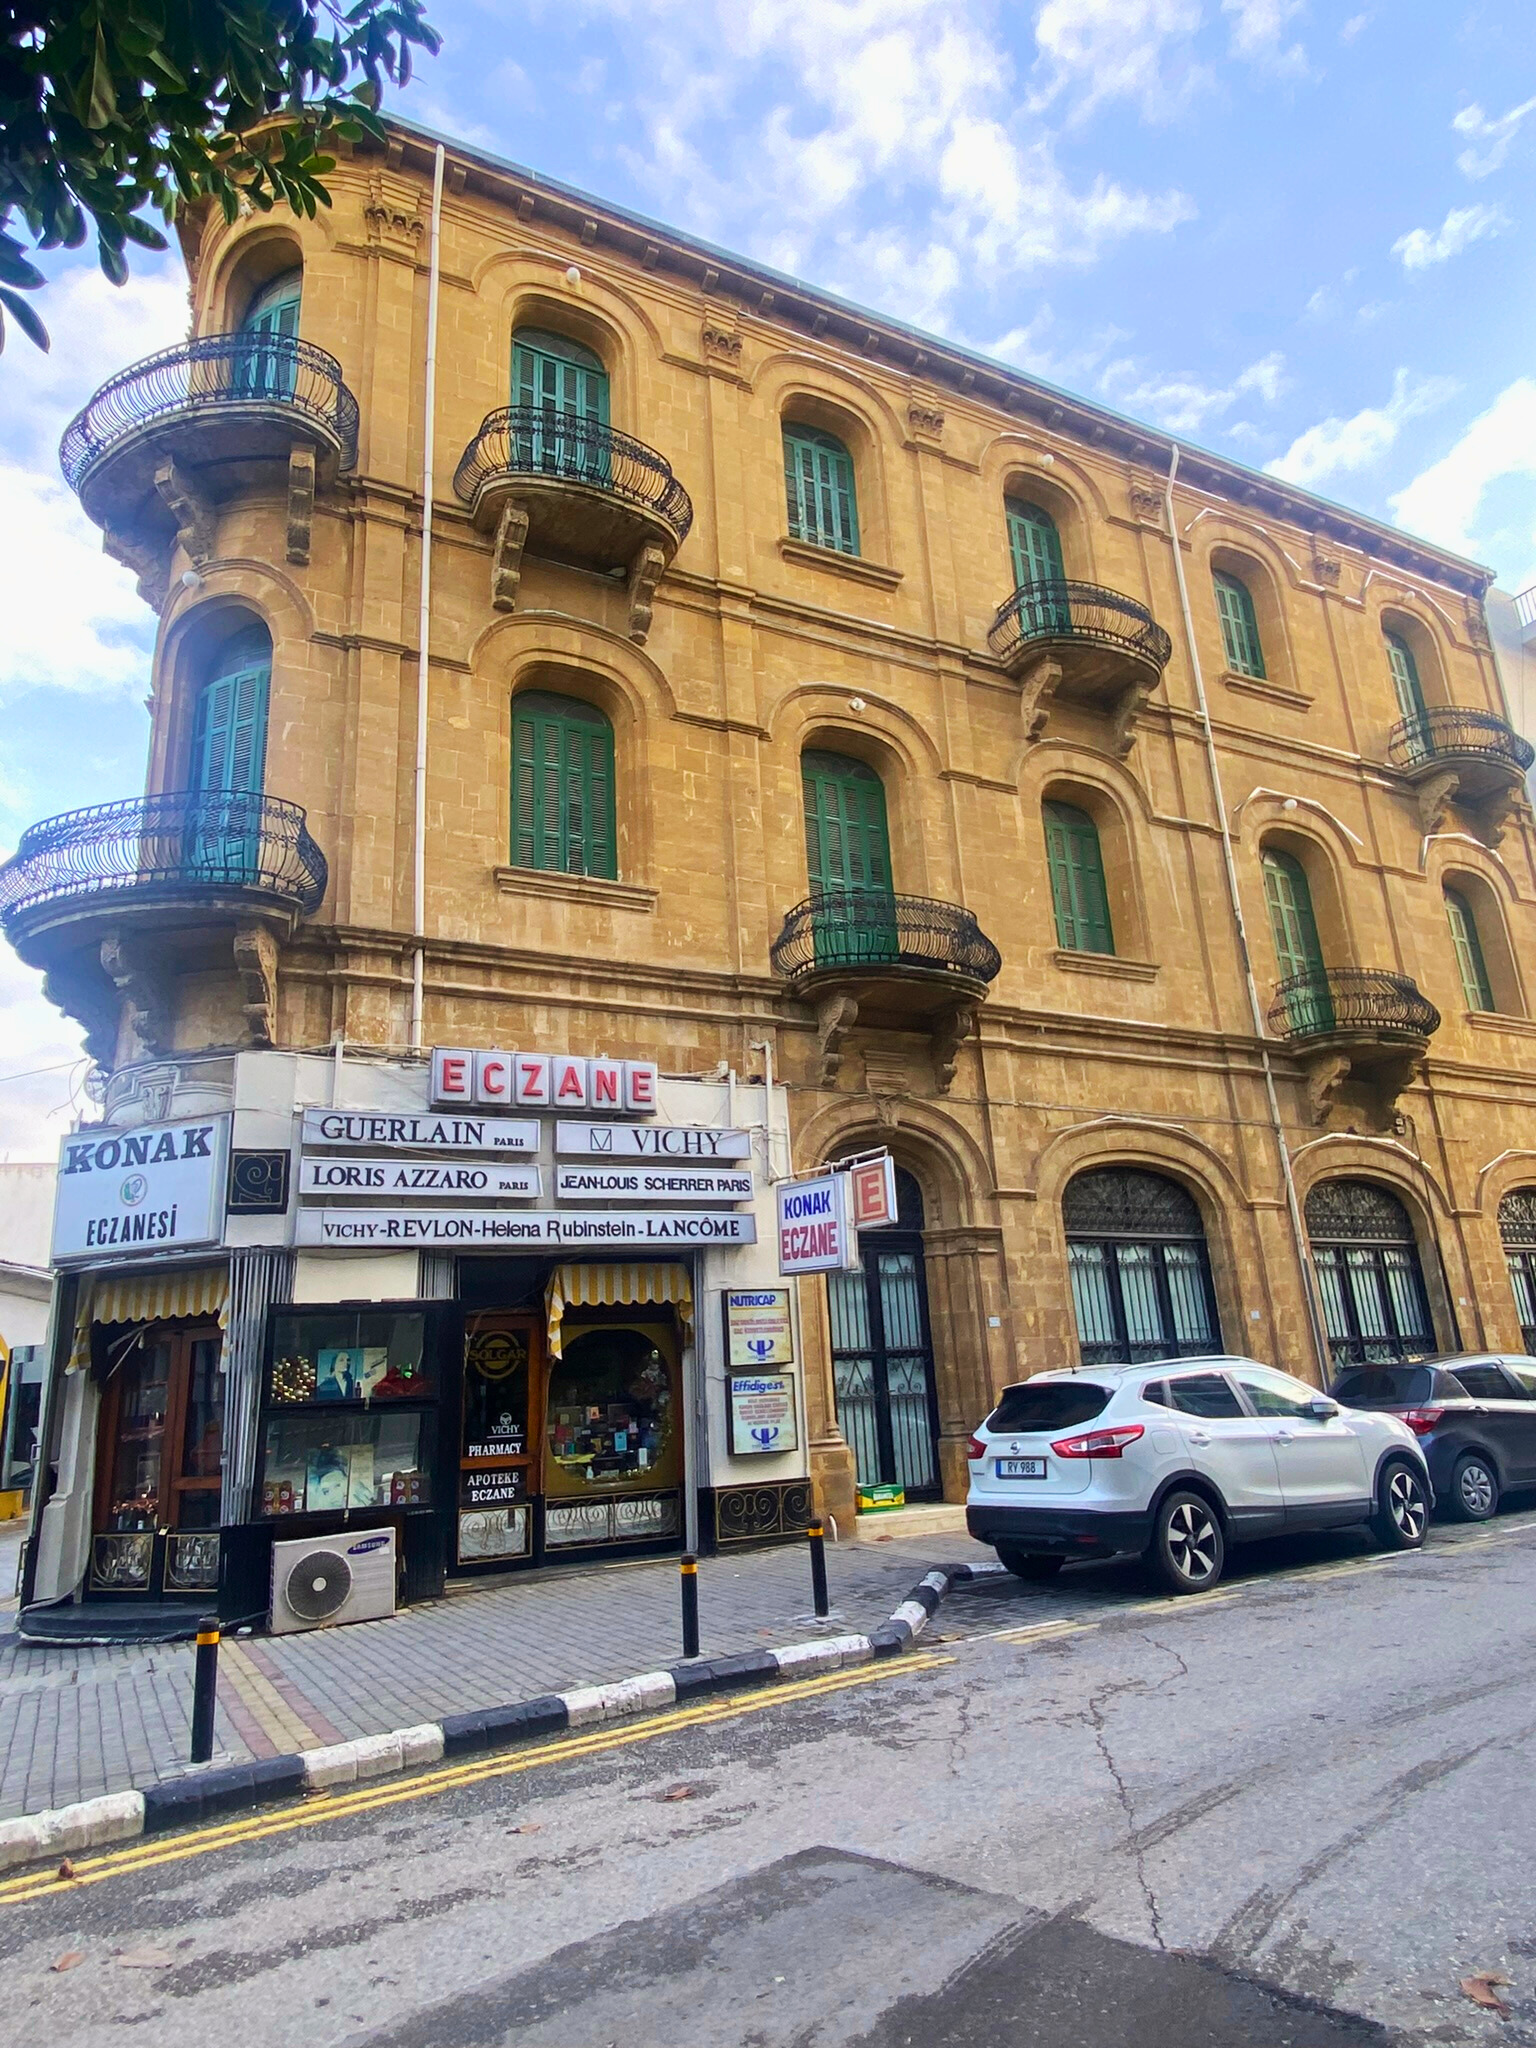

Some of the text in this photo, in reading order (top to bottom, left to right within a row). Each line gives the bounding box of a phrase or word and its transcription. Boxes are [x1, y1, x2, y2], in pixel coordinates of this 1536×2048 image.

[442, 1058, 653, 1102] ECZANE
[320, 1115, 525, 1147] GUERLAIN PARIS
[631, 1129, 723, 1156] VICHY
[64, 1126, 214, 1175] KONAK
[312, 1165, 529, 1191] LORIS AZZARO PARIS
[560, 1175, 751, 1193] JEAN-LOUIS SCHERRER PARIS
[784, 1189, 832, 1220] KONAK
[861, 1173, 882, 1214] E
[86, 1203, 178, 1247] ECZANESİ
[781, 1221, 839, 1261] ECZANE
[730, 1294, 776, 1307] NUTRICAP
[469, 1348, 527, 1361] SOLGAR
[491, 1424, 520, 1434] VICHY
[468, 1442, 521, 1457] PHARMACY
[467, 1471, 519, 1487] APOTEKE
[1007, 1461, 1036, 1474] RY 988
[471, 1486, 516, 1502] ECZANE
